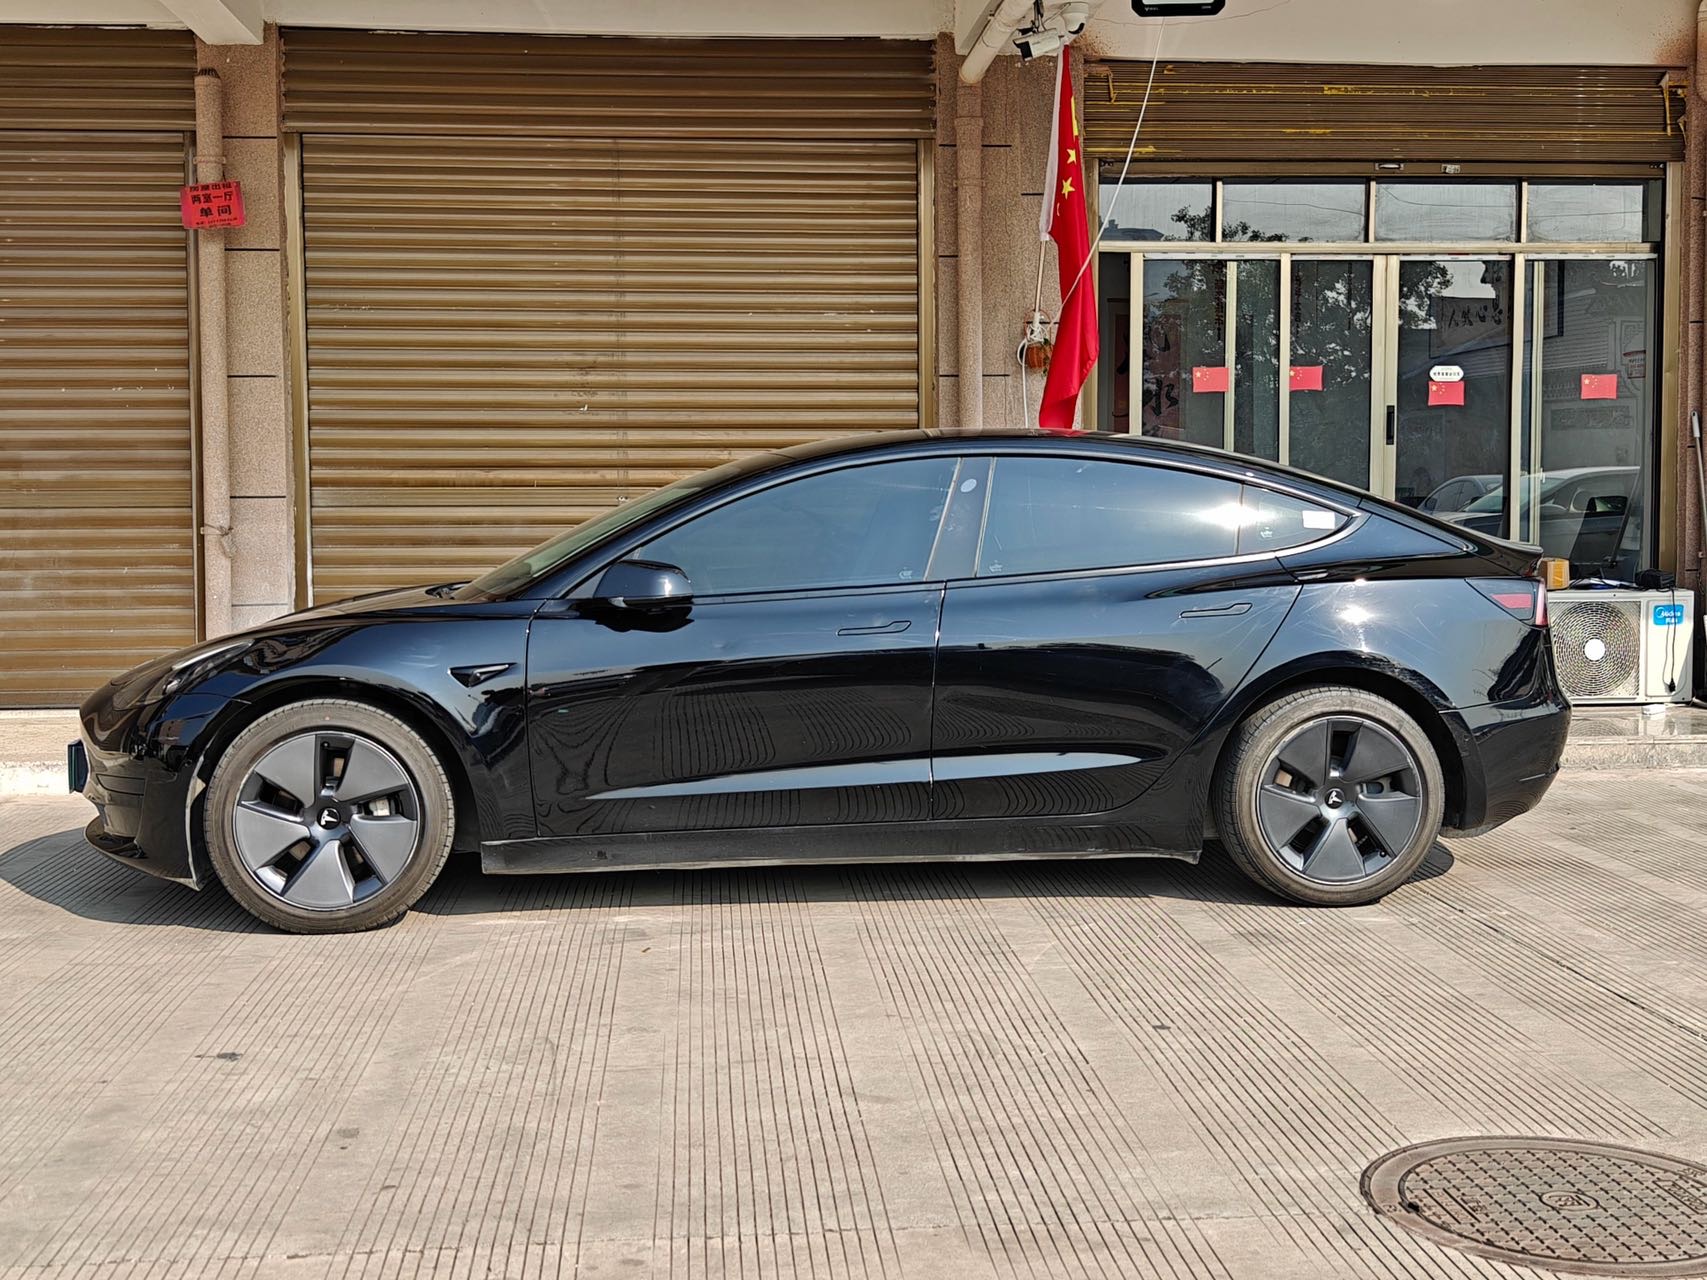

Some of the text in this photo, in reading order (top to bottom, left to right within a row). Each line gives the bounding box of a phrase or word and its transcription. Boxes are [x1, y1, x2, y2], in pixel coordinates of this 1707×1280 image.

[191, 191, 232, 204] 两室一厅
[200, 205, 231, 217] 单间
